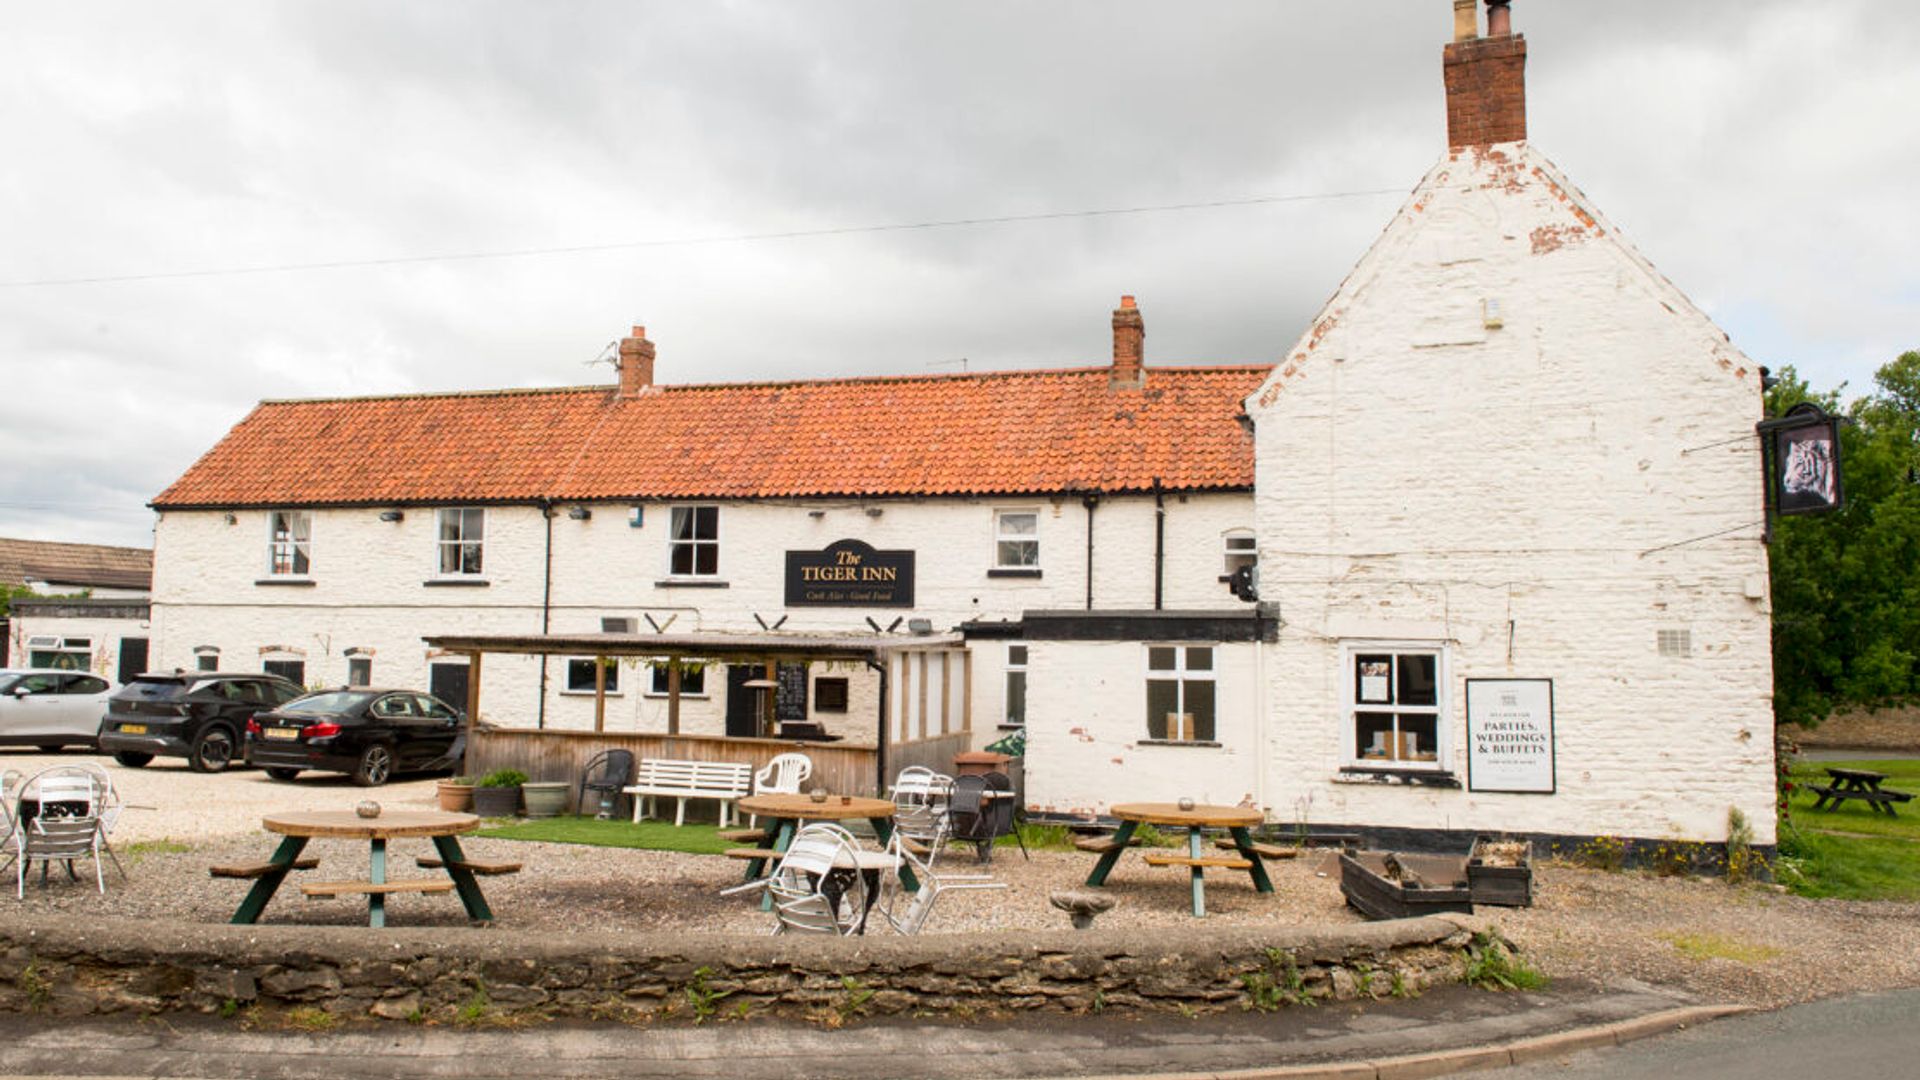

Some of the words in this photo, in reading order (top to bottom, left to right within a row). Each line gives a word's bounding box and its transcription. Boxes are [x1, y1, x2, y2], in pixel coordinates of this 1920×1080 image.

[836, 551, 861, 565] The
[801, 567, 857, 581] TIGER
[862, 567, 896, 581] INN
[1476, 733, 1546, 742] WEDDINGS
[1478, 744, 1488, 753] &
[1493, 744, 1545, 753] BUFFETS
